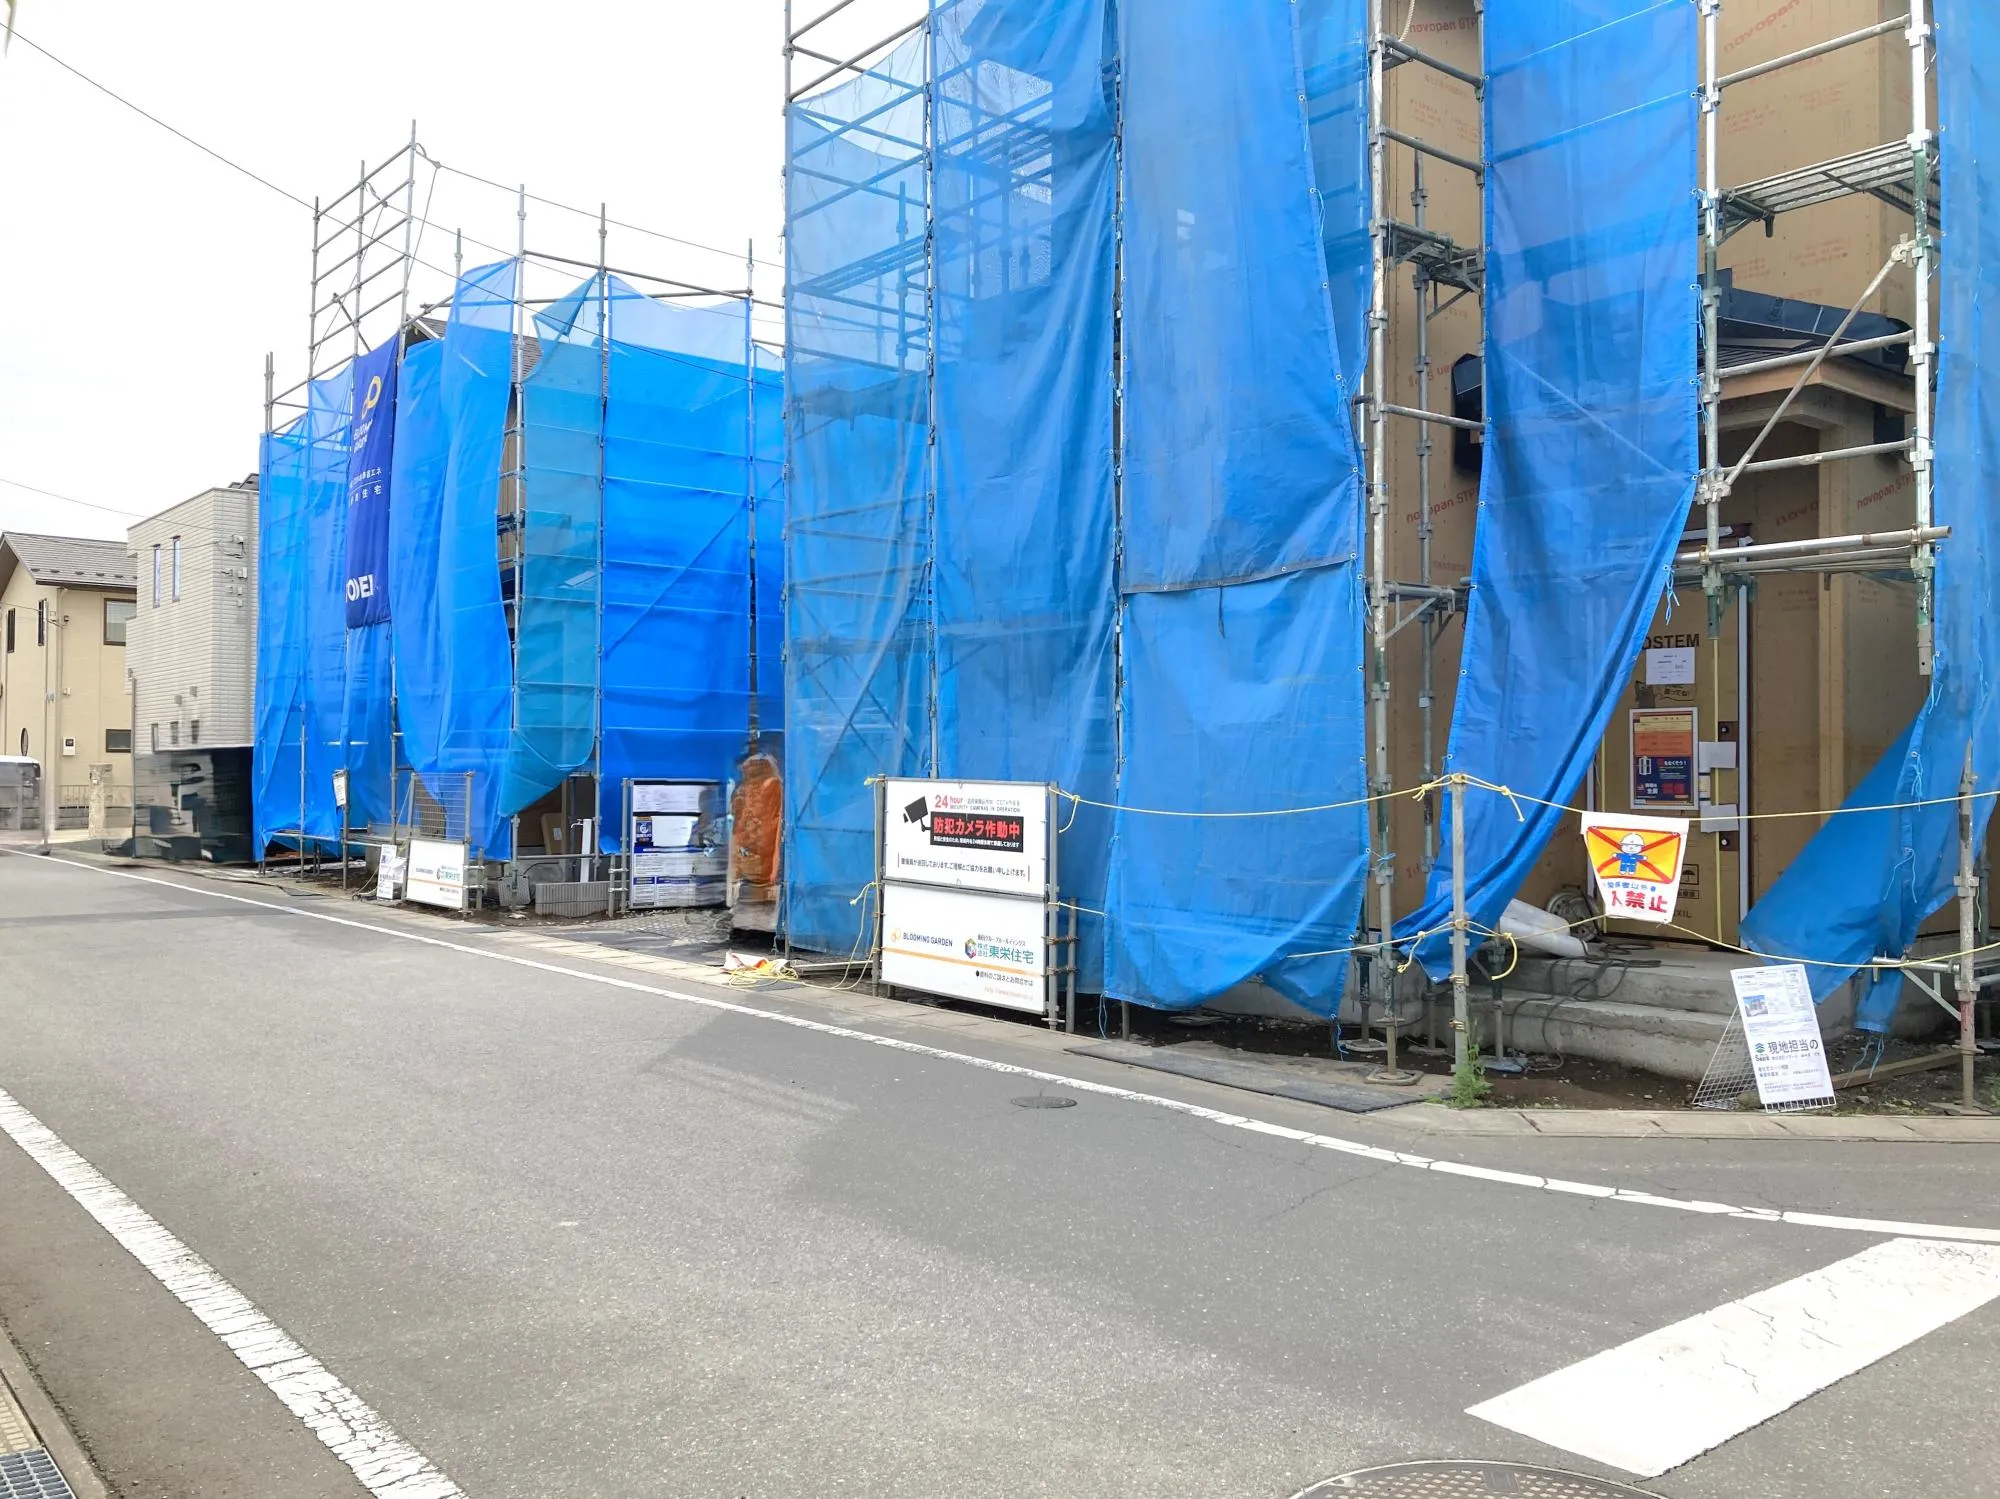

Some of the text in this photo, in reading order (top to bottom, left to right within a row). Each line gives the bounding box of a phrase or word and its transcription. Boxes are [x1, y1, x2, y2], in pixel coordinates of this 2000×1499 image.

[1724, 0, 1800, 53] novopan
[935, 794, 948, 808] 24
[933, 817, 1020, 840] 防犯カメラ作動中
[902, 932, 953, 947] BLOOMING GARDEN
[989, 945, 1034, 964] 東栄住宅
[1768, 1039, 1819, 1054] 現地担当の
